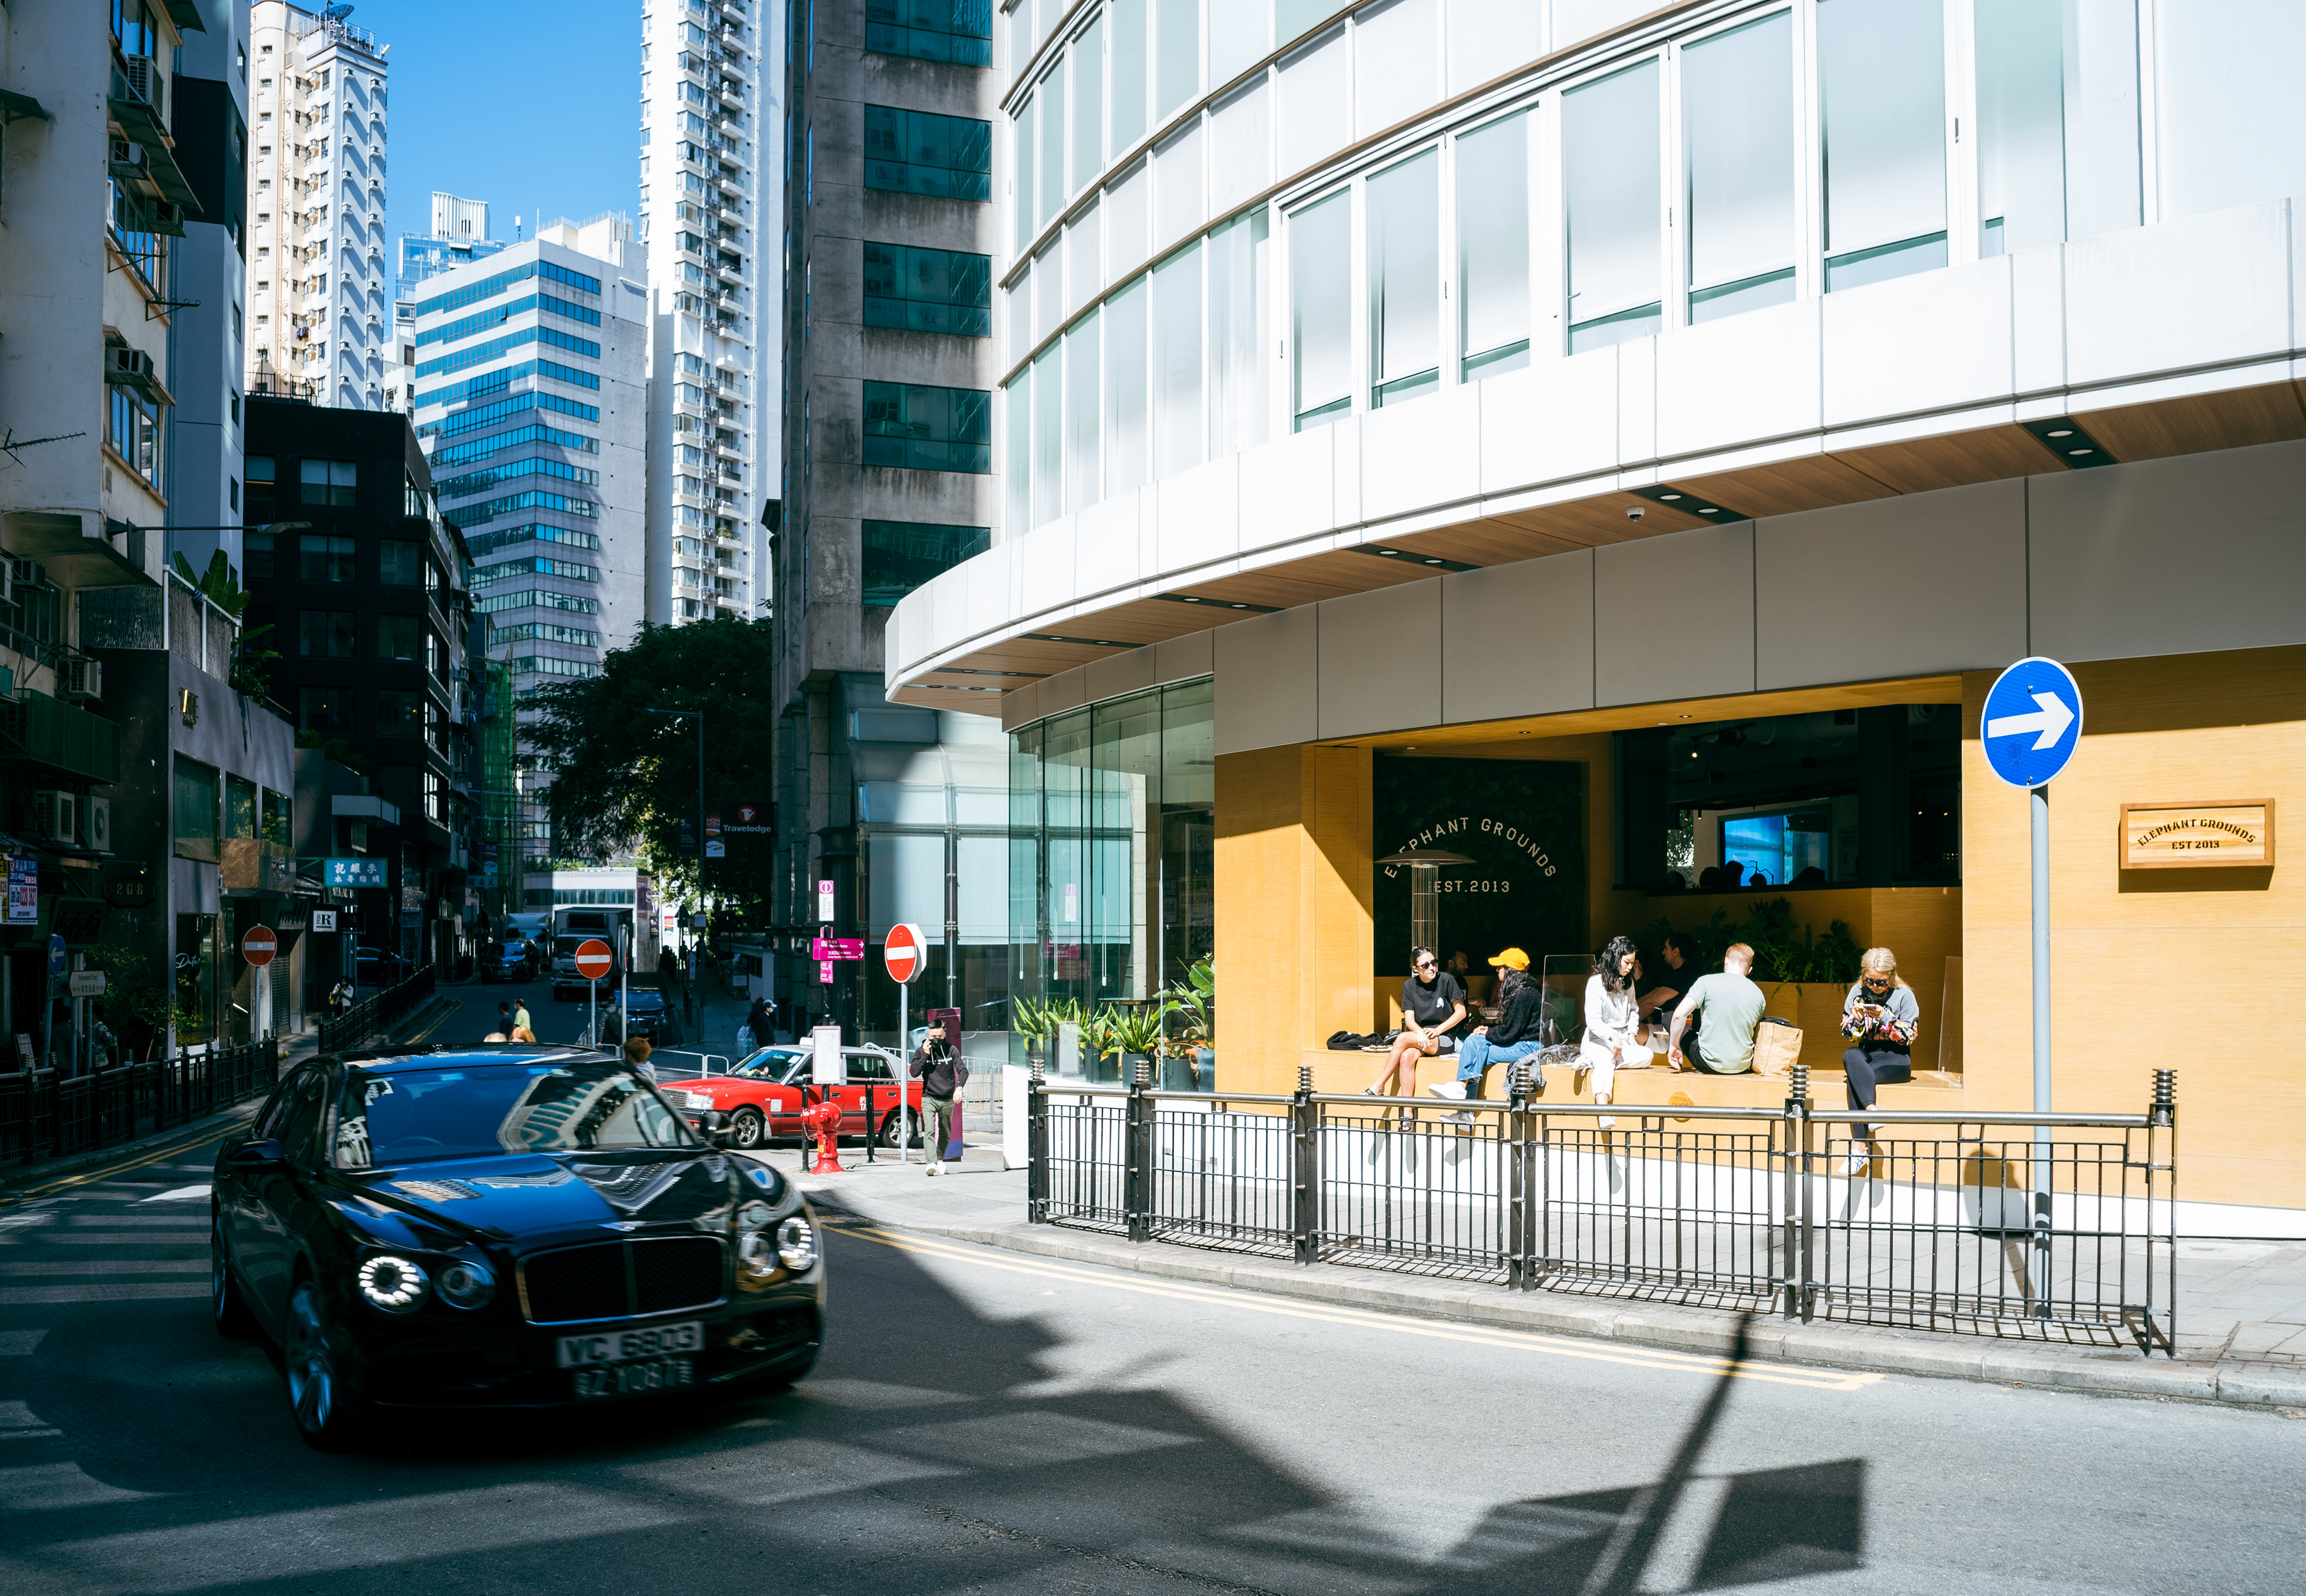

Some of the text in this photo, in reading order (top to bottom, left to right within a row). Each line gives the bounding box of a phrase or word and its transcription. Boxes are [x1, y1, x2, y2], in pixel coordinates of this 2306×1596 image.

[722, 824, 772, 833] Travelodge
[2137, 819, 2256, 847] ELEPHANT GROUNDS
[1481, 818, 1556, 877] GROUNDS
[2195, 840, 2220, 848] 2013
